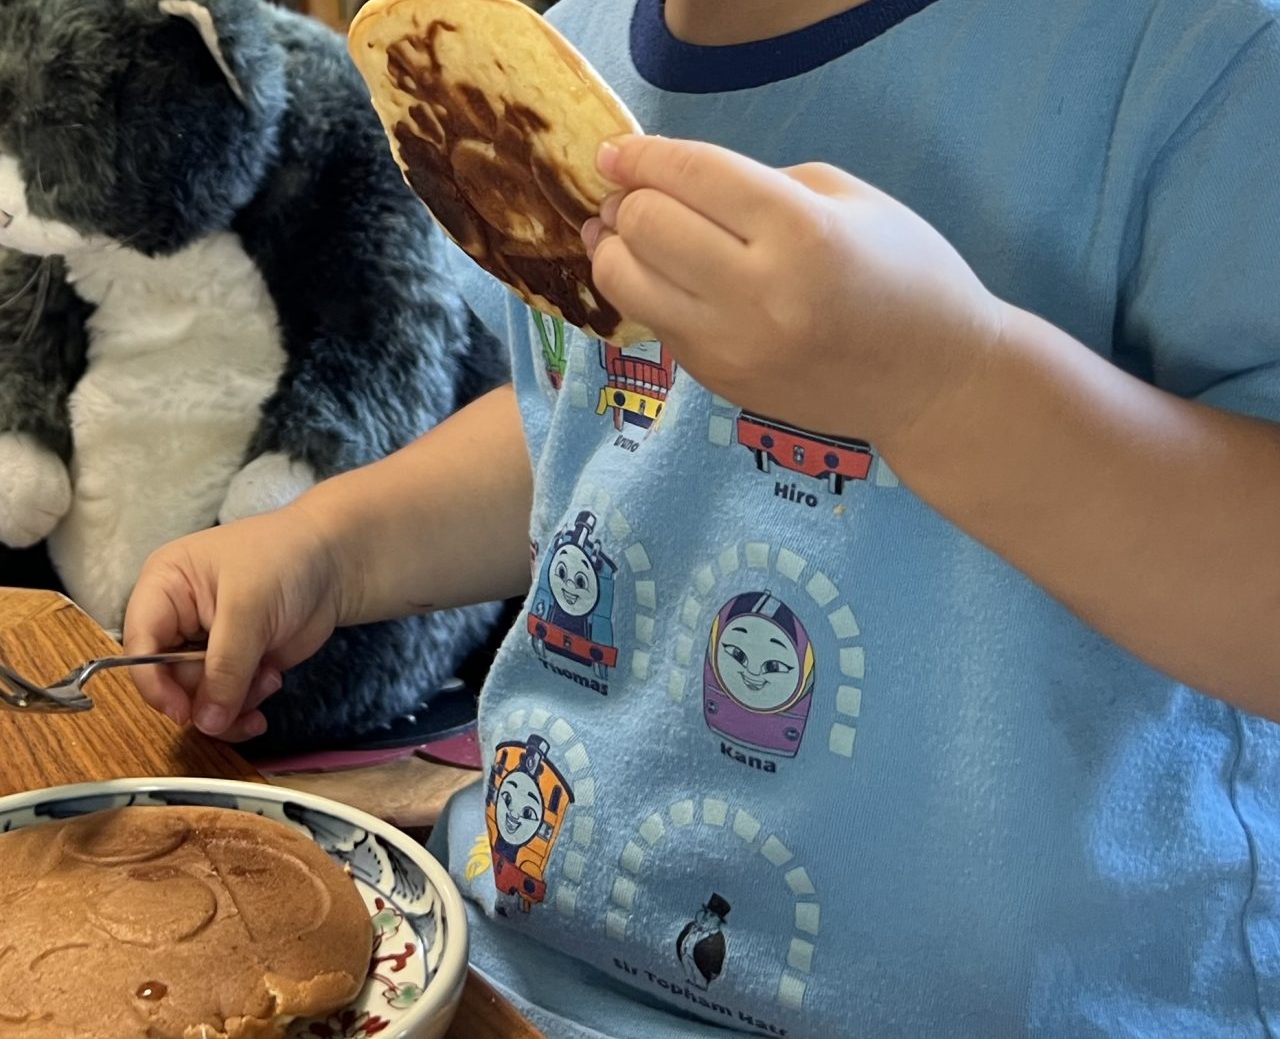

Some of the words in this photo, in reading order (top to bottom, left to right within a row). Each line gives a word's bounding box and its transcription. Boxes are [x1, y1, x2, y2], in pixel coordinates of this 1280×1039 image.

[774, 481, 818, 508] Hiro
[537, 656, 609, 696] Thomas
[720, 741, 776, 773] Kana
